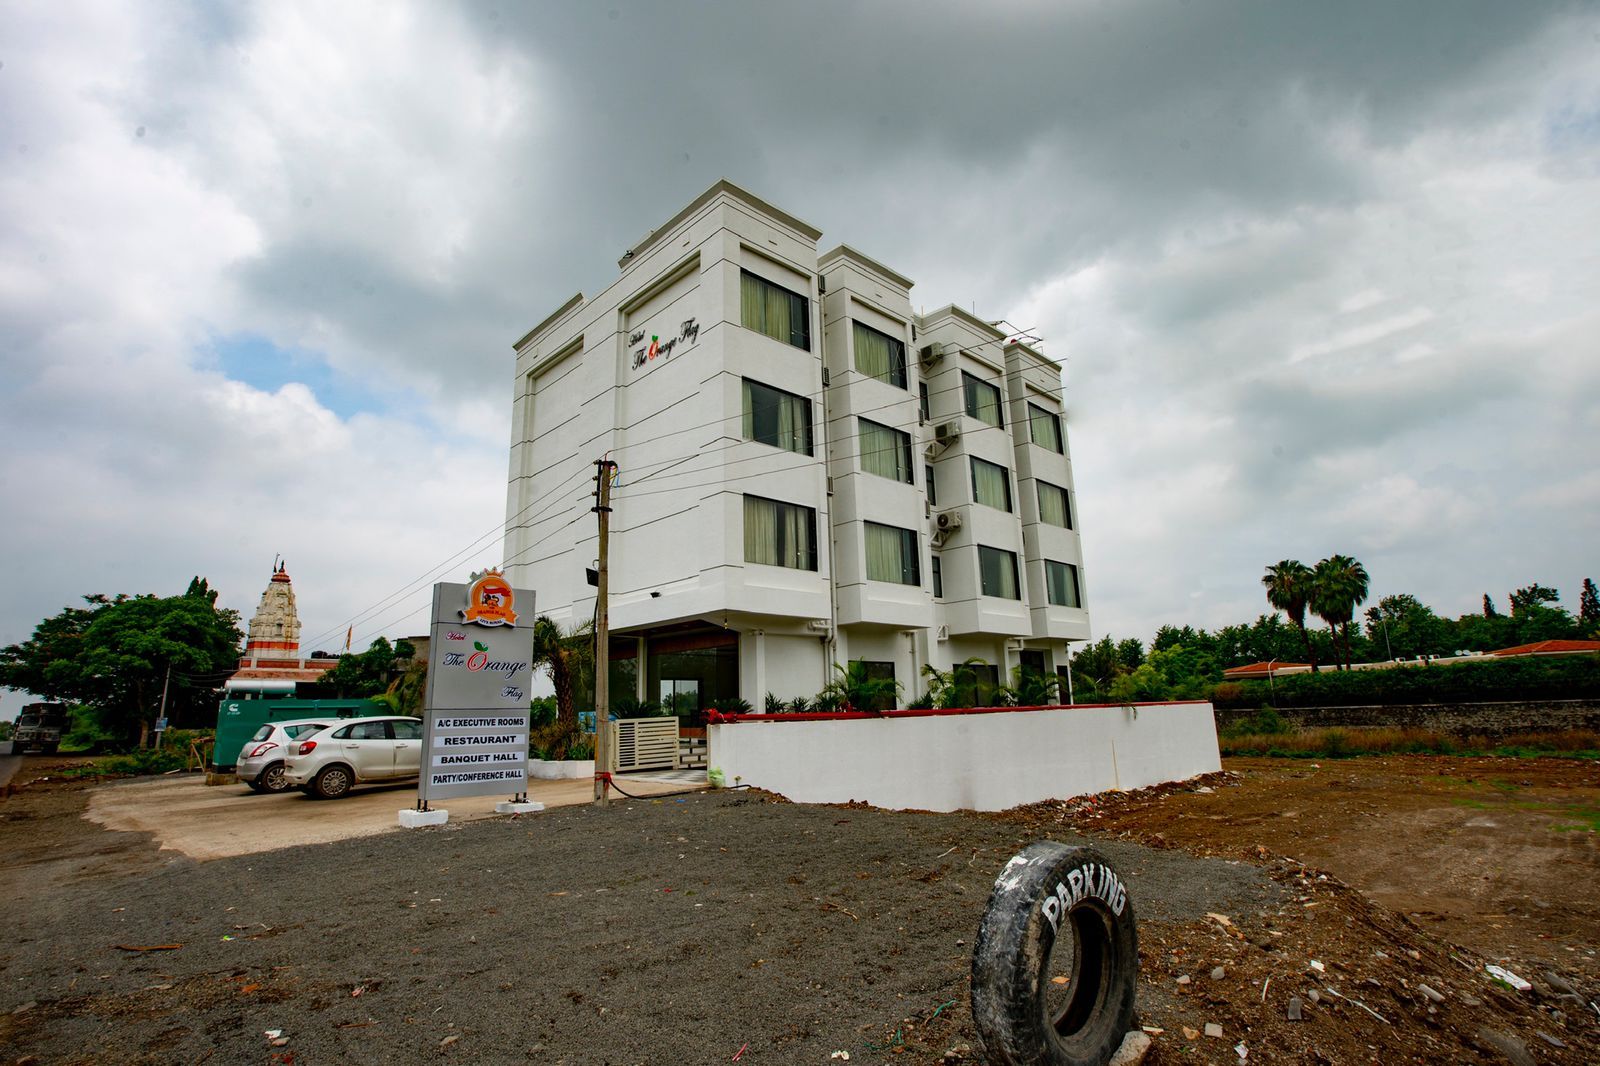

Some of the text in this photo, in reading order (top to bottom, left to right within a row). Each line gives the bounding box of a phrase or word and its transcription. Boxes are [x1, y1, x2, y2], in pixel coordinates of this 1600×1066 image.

[632, 317, 700, 371] The Orange Flag
[445, 632, 467, 641] Hotel
[443, 651, 527, 679] The Orange
[501, 686, 524, 702] Flag
[437, 718, 525, 728] A/C EXECUTIVE ROOMS
[444, 735, 517, 746] RESTAURANT
[440, 753, 518, 764] BANQUET HALL
[433, 770, 523, 784] PARTY/CONFERENCE HALL
[1041, 862, 1127, 936] PARKING
